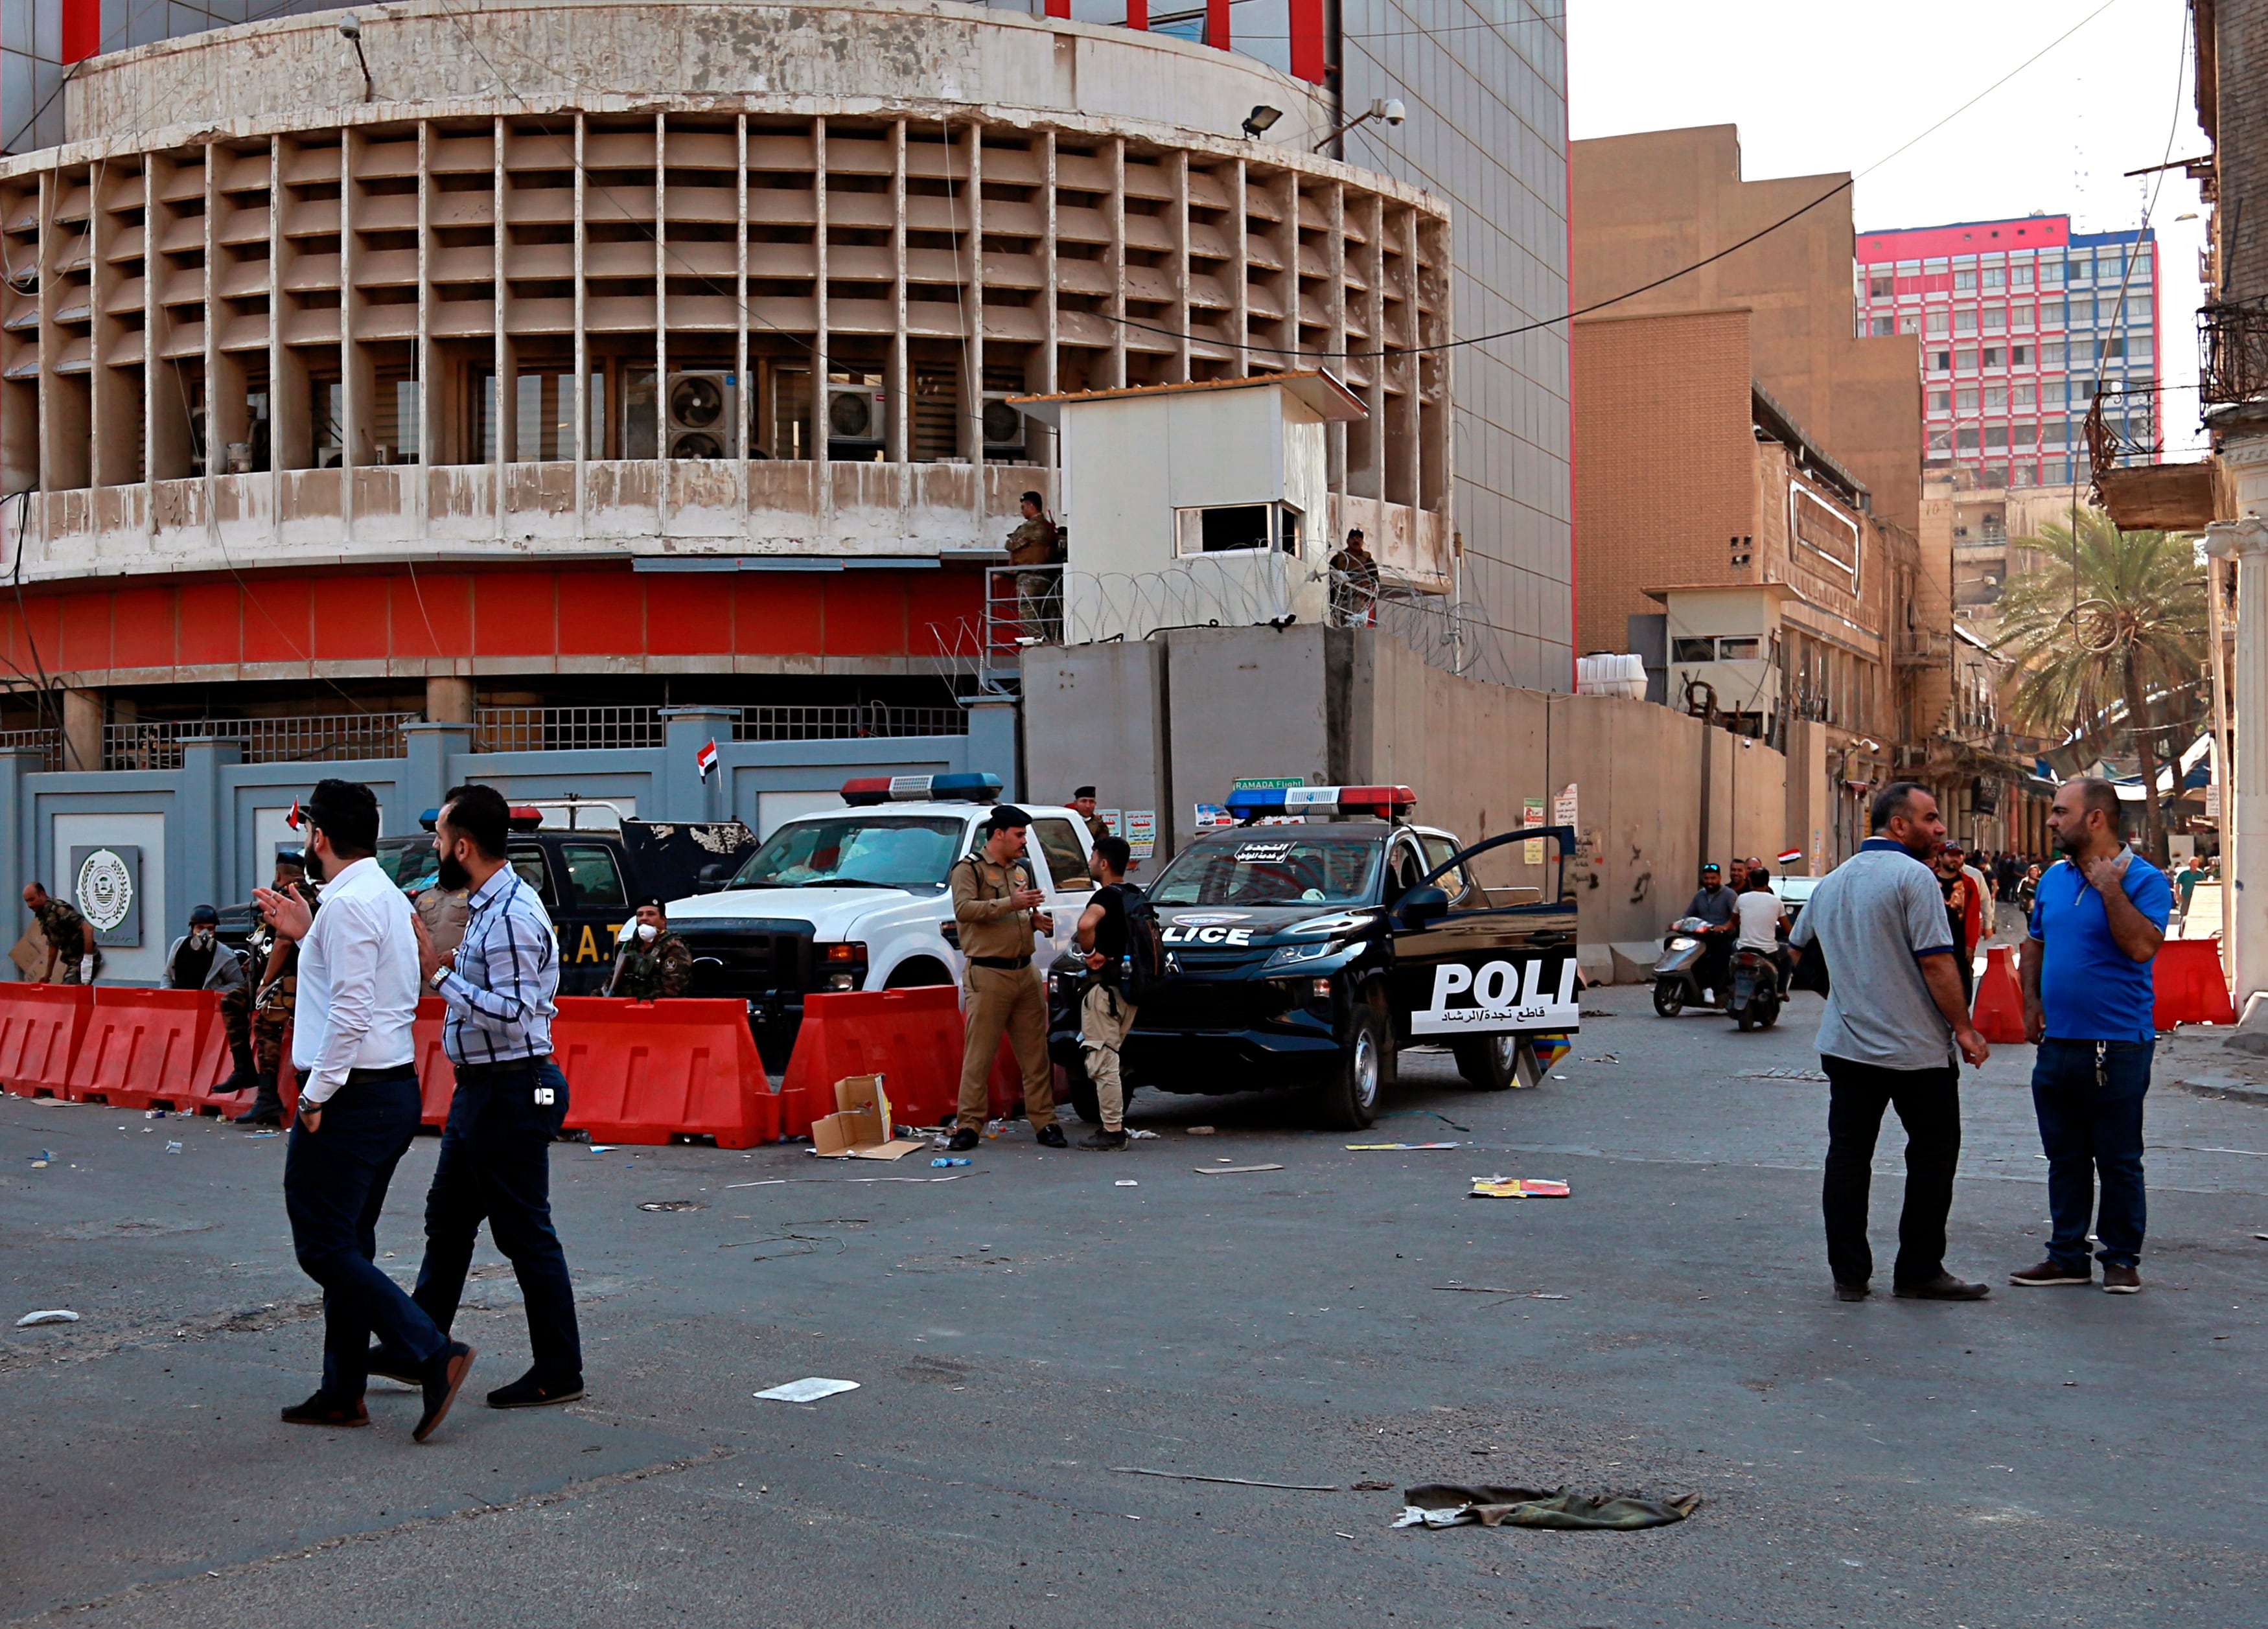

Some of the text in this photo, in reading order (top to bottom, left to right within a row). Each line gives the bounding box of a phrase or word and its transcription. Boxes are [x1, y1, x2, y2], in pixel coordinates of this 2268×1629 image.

[1244, 844, 1290, 852] النجدة
[1161, 927, 1255, 946] LICE
[1430, 958, 1577, 1011] POLI
[1516, 1006, 1545, 1022] قاطع
